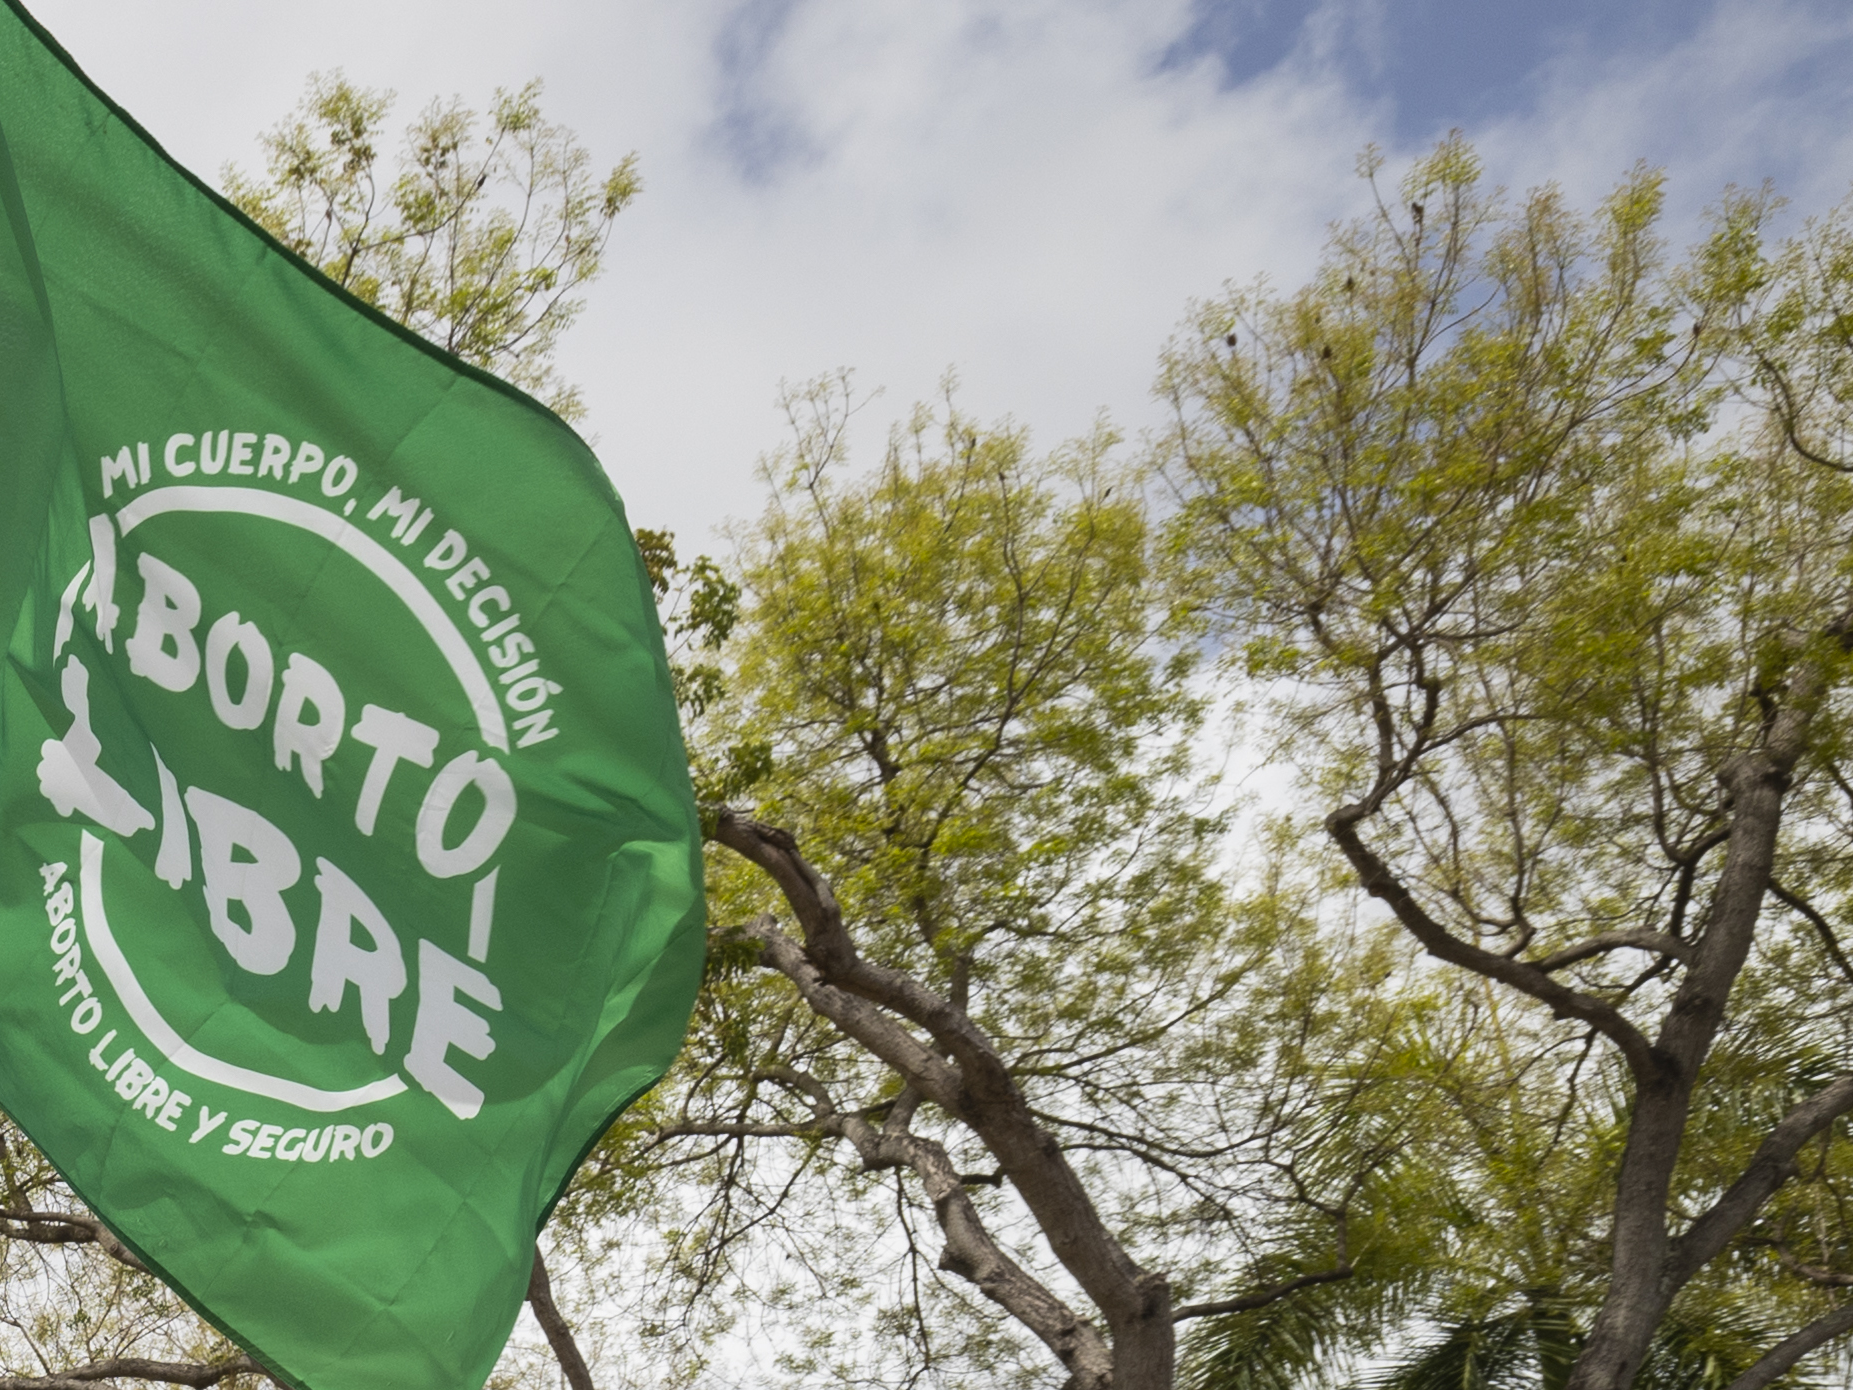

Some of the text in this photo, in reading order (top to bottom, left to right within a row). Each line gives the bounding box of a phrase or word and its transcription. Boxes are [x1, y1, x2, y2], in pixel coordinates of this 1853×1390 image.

[82, 514, 517, 878] ABORTO
[100, 430, 565, 749] MI CUERPO, MI DECISIÓN
[36, 654, 503, 1120] LIBRE
[38, 862, 394, 1163] ABORTO LIBRE Y SEGURO
